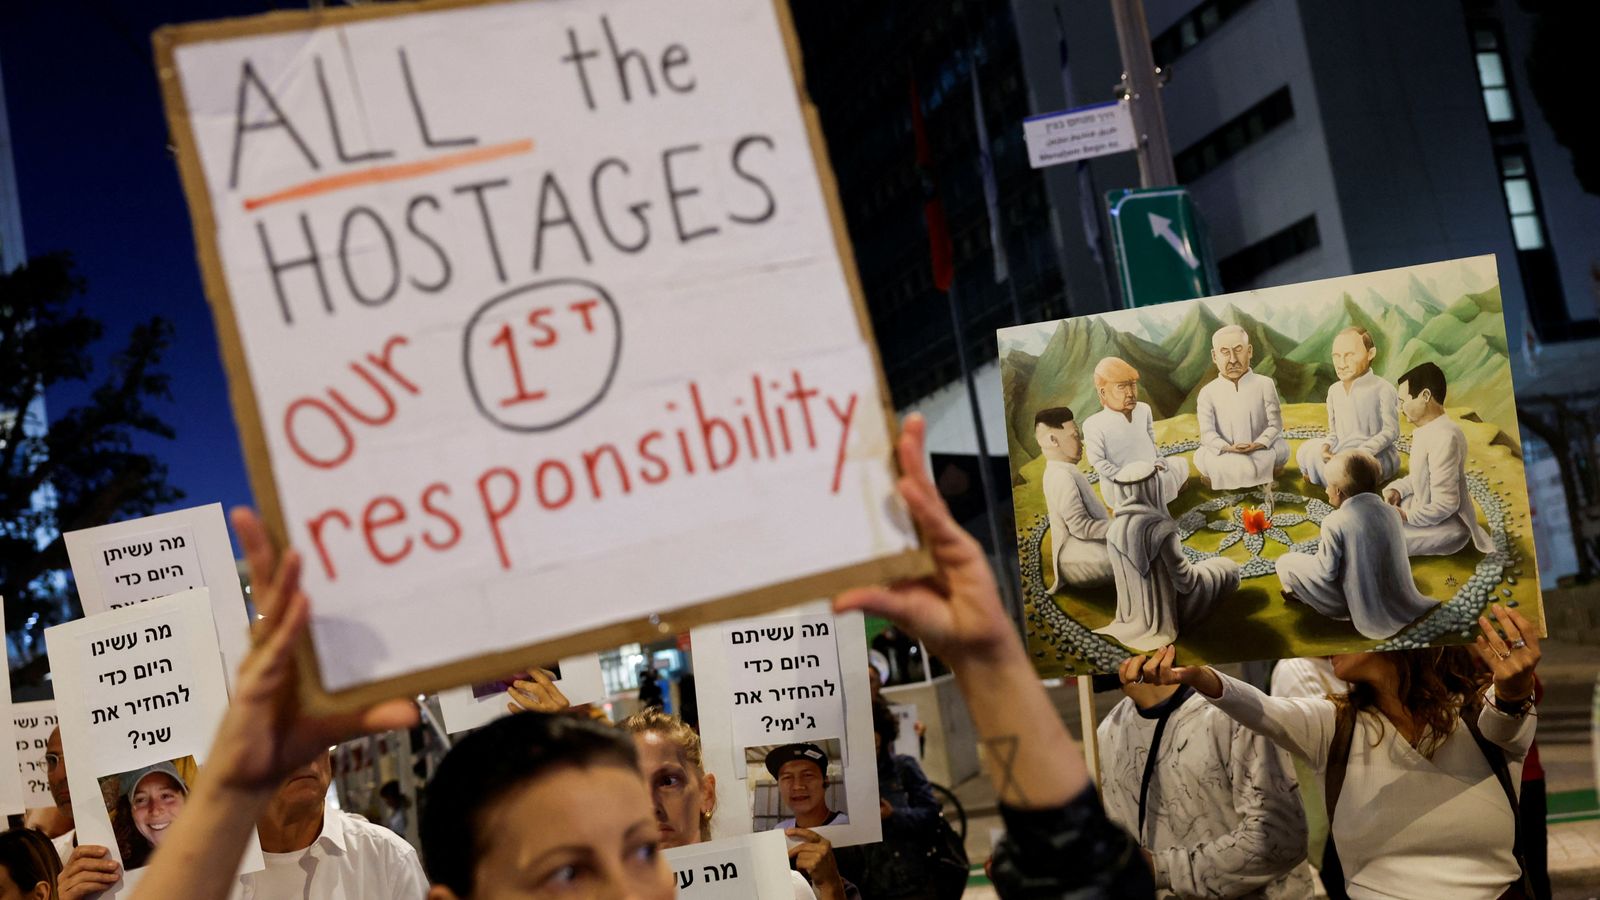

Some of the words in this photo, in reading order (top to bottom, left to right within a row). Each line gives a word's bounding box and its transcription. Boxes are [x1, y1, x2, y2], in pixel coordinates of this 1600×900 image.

[228, 46, 478, 190] ALL
[562, 17, 697, 110] the
[256, 134, 777, 325] HOSTAGES
[490, 300, 601, 407] 1ST
[306, 369, 859, 581] responsibility
[103, 541, 153, 566] עשיתן
[159, 535, 186, 552] מה
[114, 572, 142, 586] כדי
[147, 564, 184, 582] היום
[144, 624, 172, 643] מה
[731, 626, 794, 645] עשיתם
[801, 622, 830, 638] מה
[91, 631, 138, 657] עשינו
[133, 658, 173, 680] היום
[744, 659, 773, 673] כדי
[780, 654, 820, 671] היום
[98, 669, 127, 686] כדי
[124, 684, 190, 715] להחזיר
[733, 690, 763, 705] את
[768, 679, 835, 702] להחזיר
[91, 705, 120, 725] את
[760, 712, 817, 733] ג'ימי?
[127, 726, 172, 749] שני?
[703, 862, 738, 883] מה
